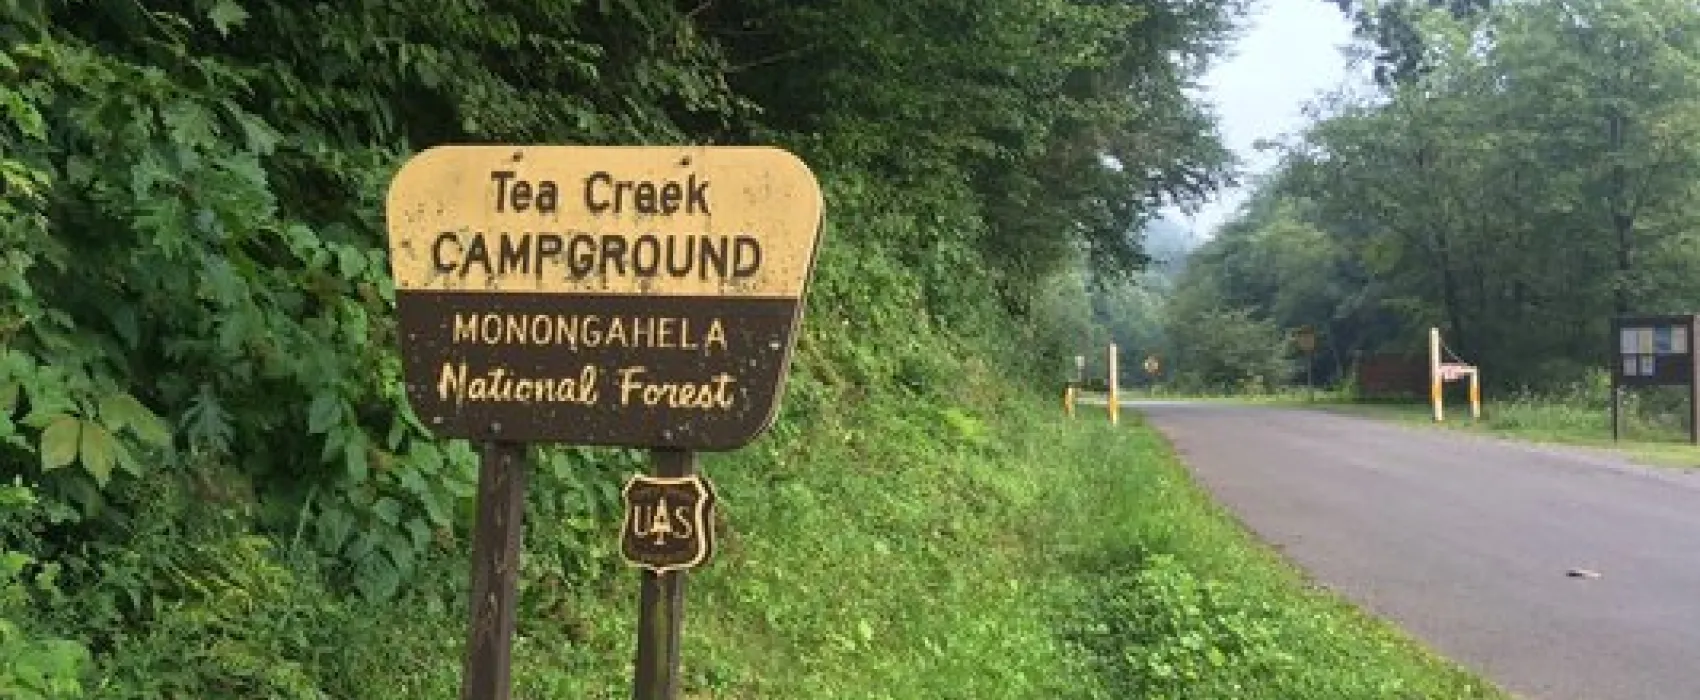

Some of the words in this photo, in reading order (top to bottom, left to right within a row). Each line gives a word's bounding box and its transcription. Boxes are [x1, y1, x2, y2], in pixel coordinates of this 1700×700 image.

[490, 170, 558, 214] Tea
[432, 232, 763, 279] CAMPGROUND
[452, 313, 728, 352] MONONGAHELA
[437, 362, 598, 405] National
[618, 365, 736, 410] Forest
